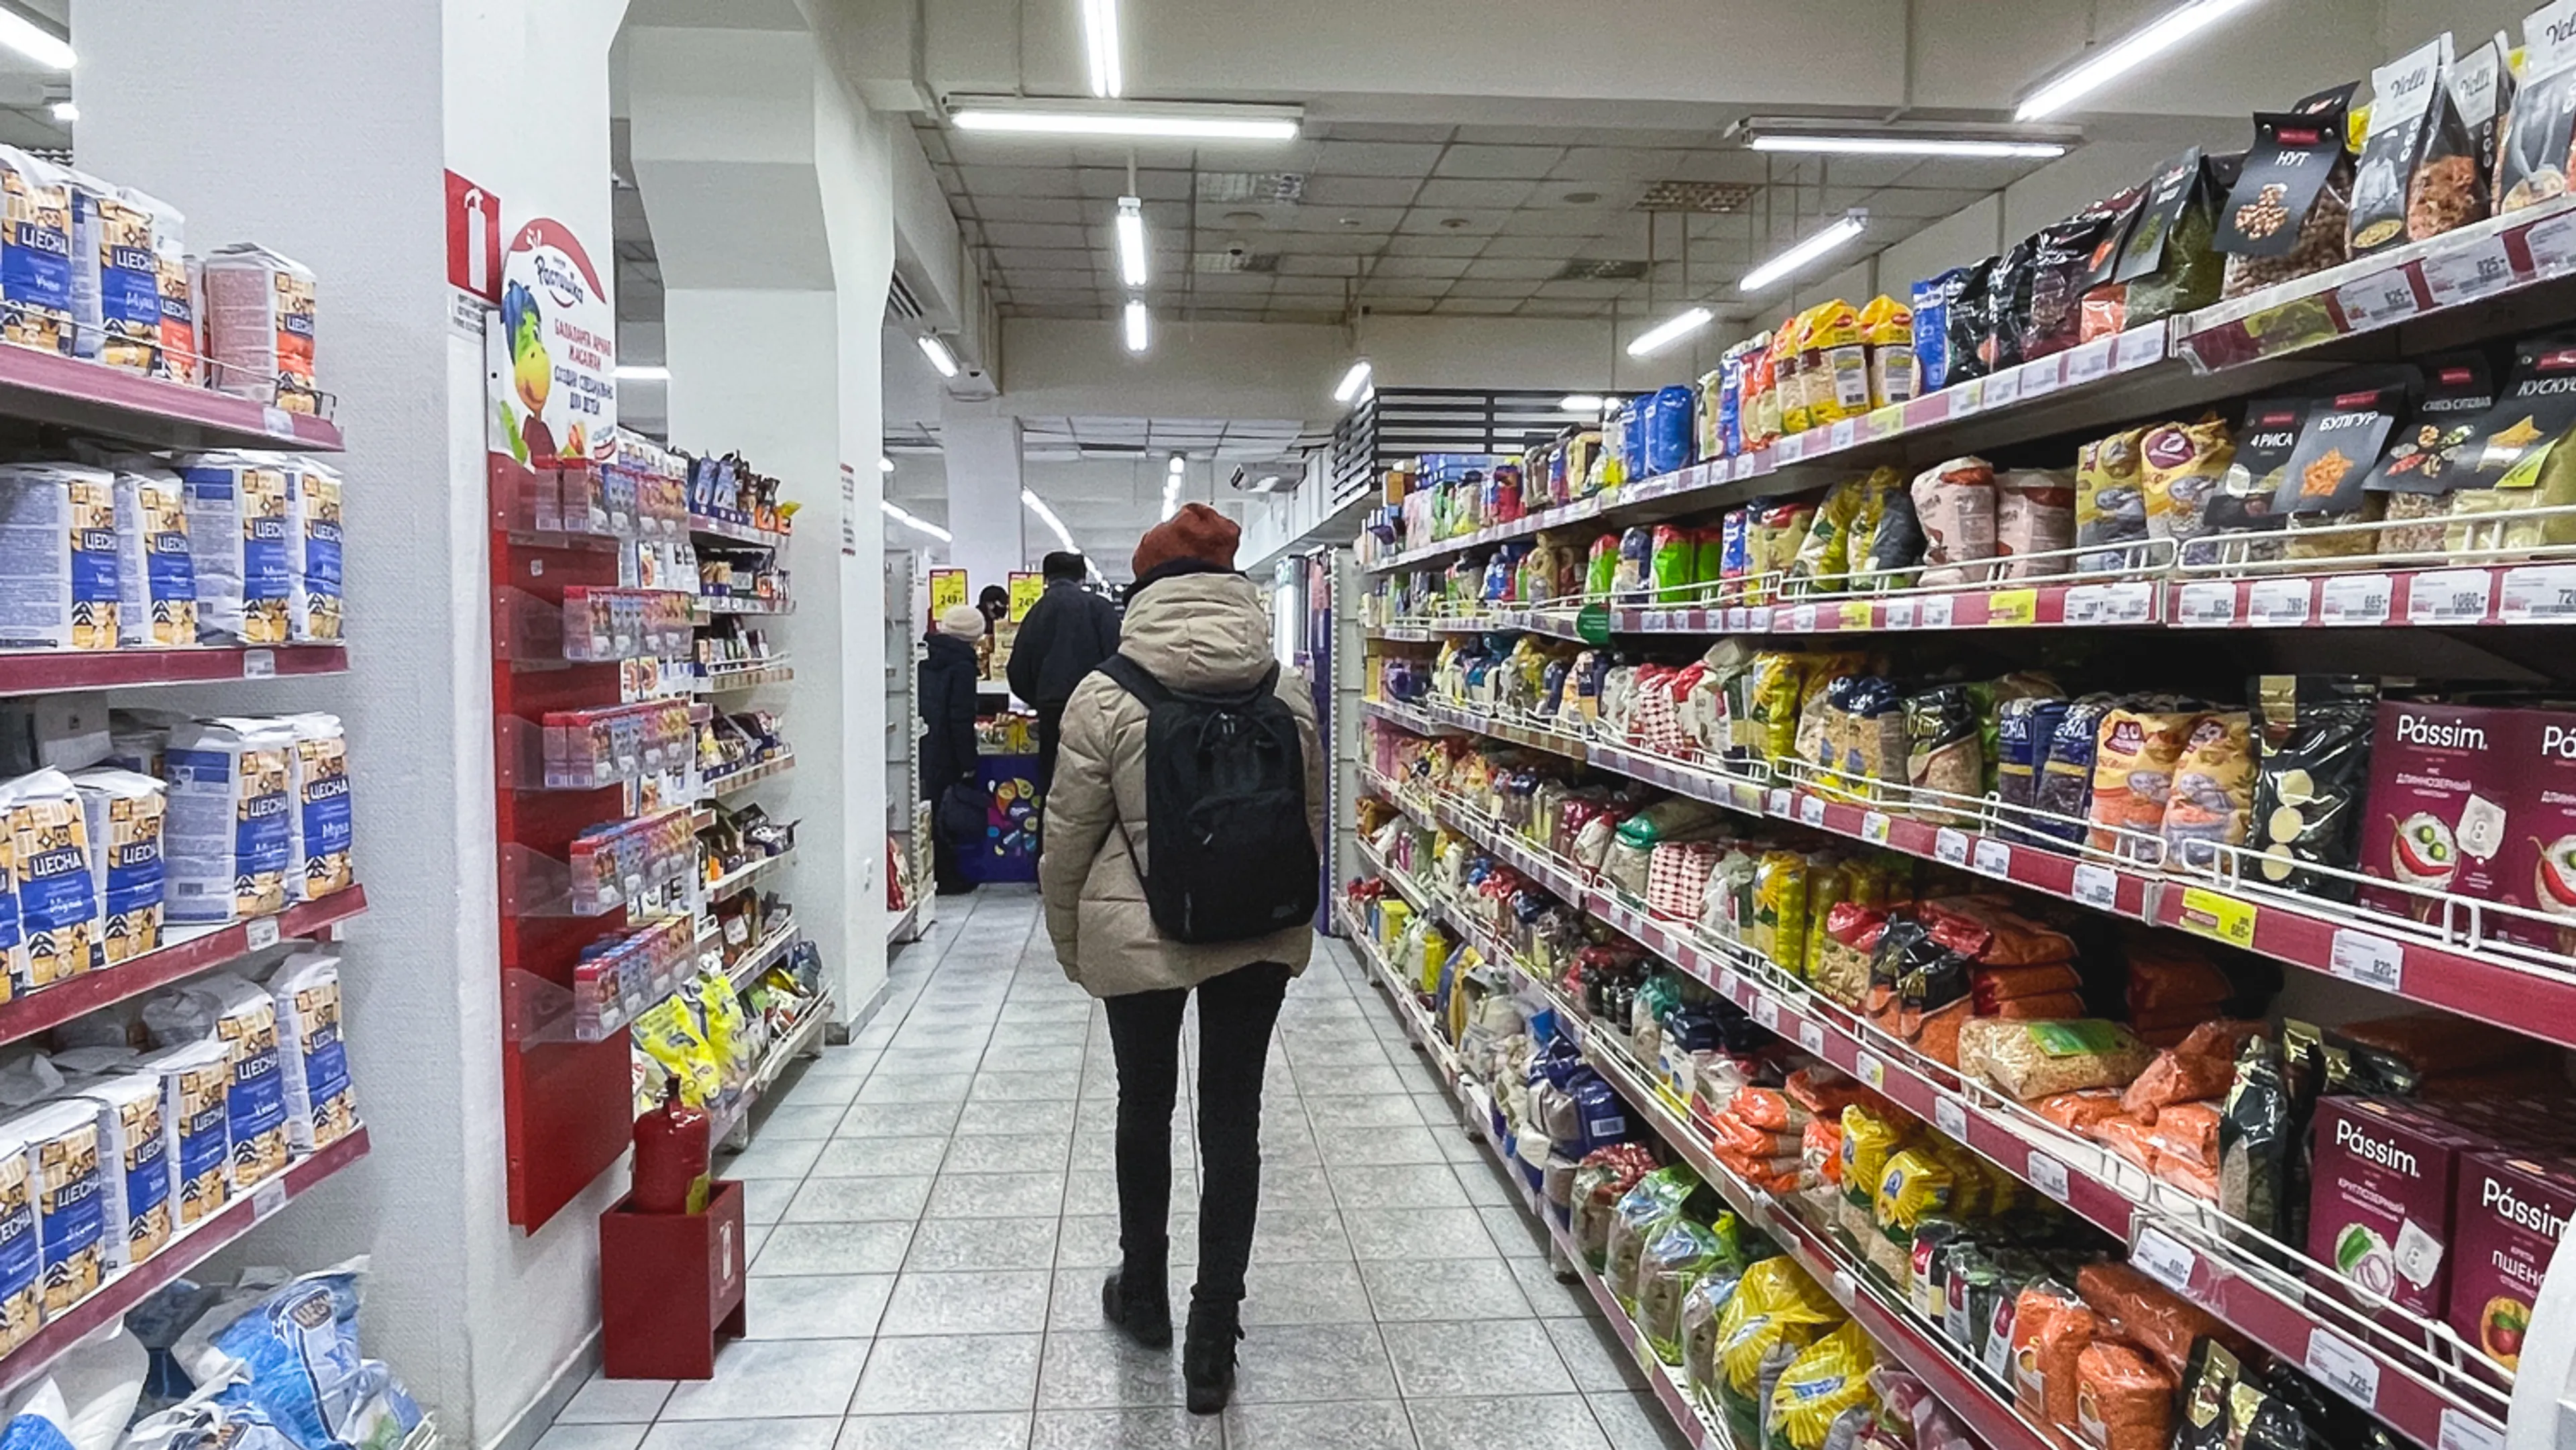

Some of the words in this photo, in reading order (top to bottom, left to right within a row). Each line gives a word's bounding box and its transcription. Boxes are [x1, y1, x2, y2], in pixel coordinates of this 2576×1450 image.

[2275, 150, 2310, 166] НУТ
[2318, 411, 2379, 431] БУЛГУР
[2250, 435, 2259, 447] 4
[2259, 433, 2293, 448] РИСА
[2559, 589, 2576, 604] 72
[34, 851, 83, 878] ЦЕСНА
[0, 1207, 32, 1241] ЕСНА
